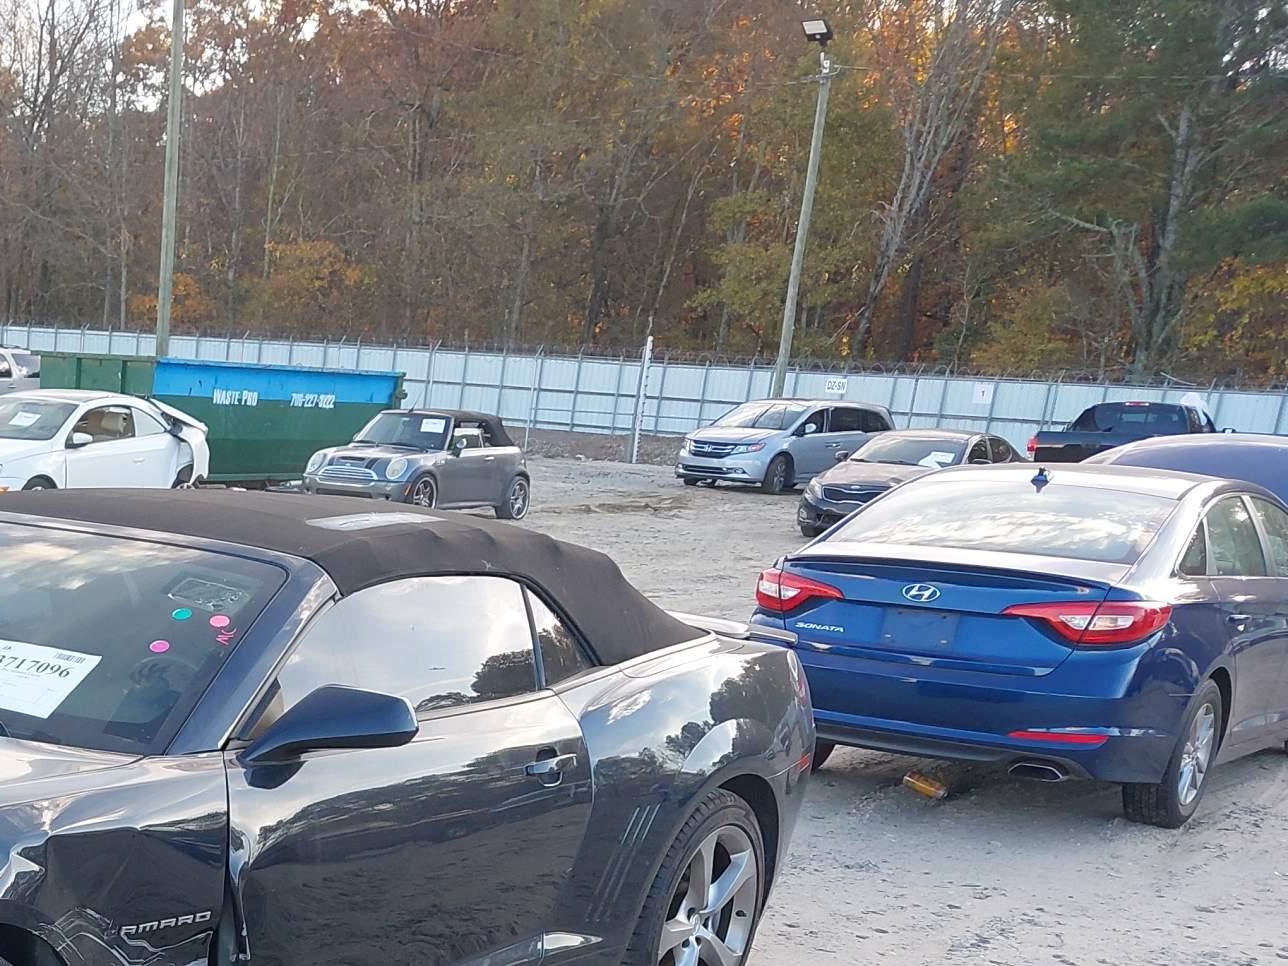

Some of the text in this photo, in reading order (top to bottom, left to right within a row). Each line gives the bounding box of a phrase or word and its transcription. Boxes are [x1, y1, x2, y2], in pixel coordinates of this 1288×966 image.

[212, 388, 258, 407] WASTE PRO
[794, 621, 844, 633] SONATA
